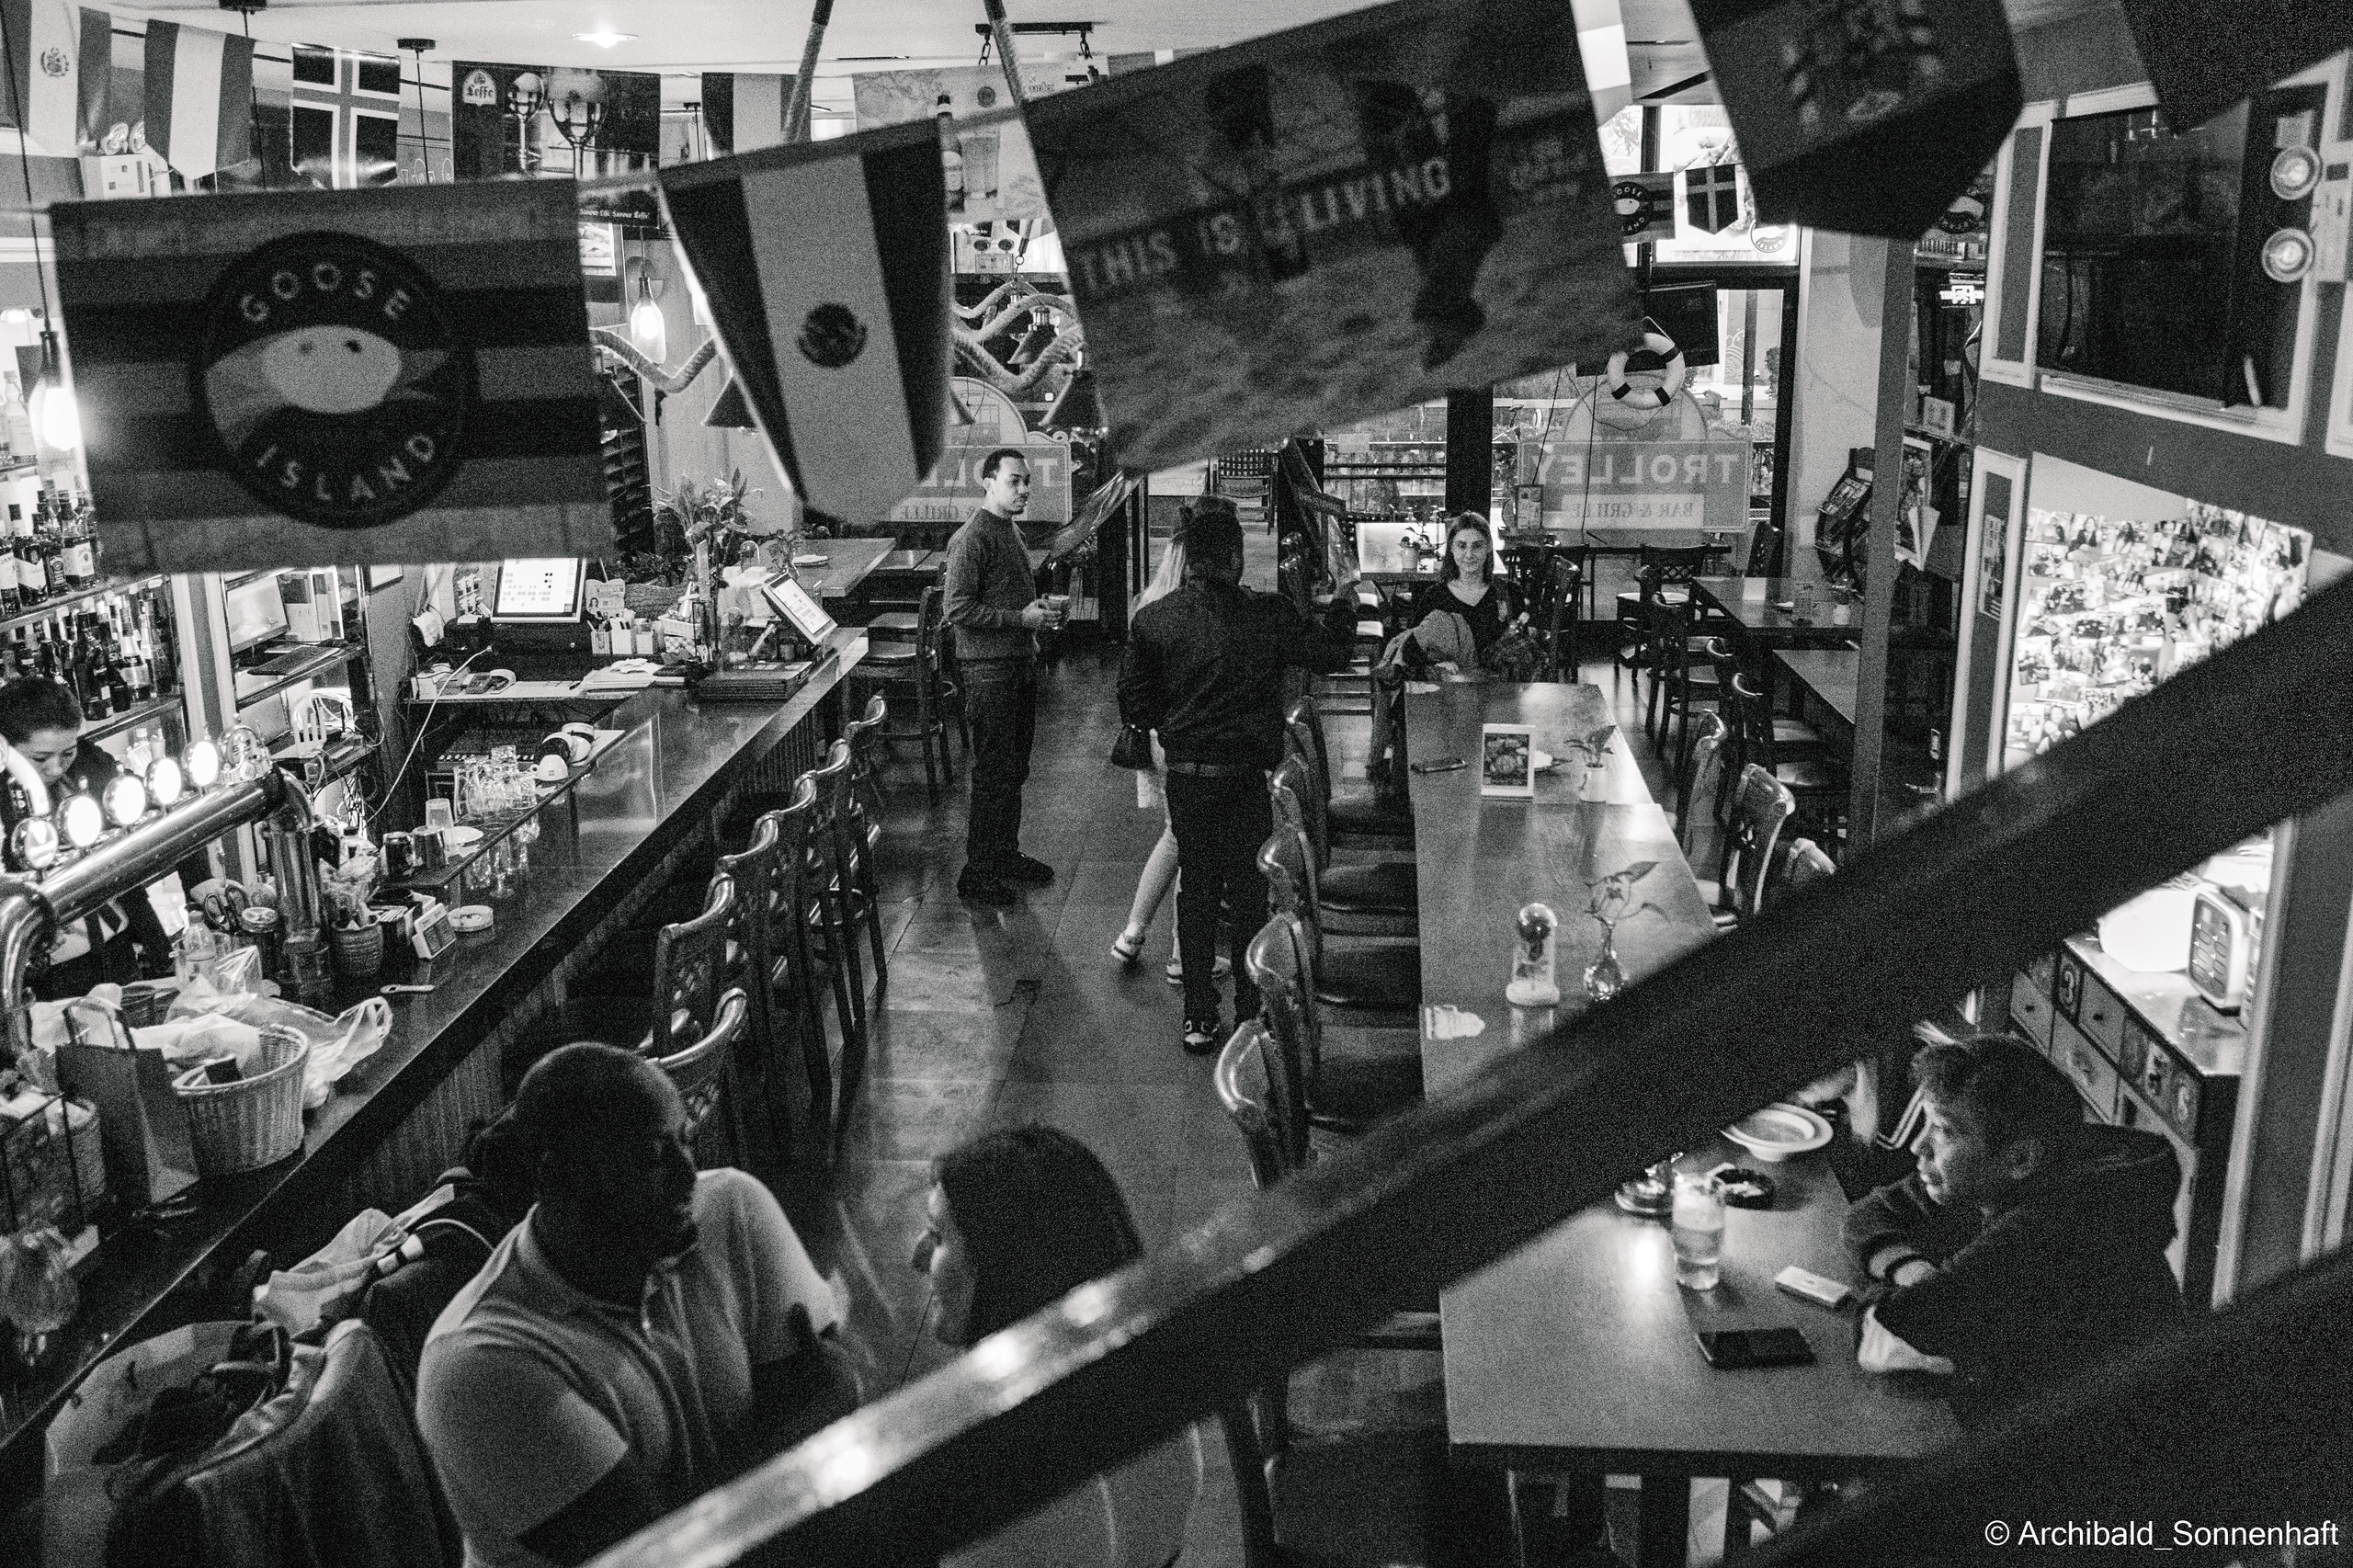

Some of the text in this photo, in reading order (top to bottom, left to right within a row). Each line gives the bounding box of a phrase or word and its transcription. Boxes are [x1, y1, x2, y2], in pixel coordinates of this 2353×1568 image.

[1074, 230, 1176, 292] THIS
[1199, 212, 1241, 256] IS
[1301, 155, 1452, 233] LIVING
[1617, 187, 1643, 198] OOSE
[240, 262, 410, 322] GOOSE
[256, 432, 435, 502] ISLAND
